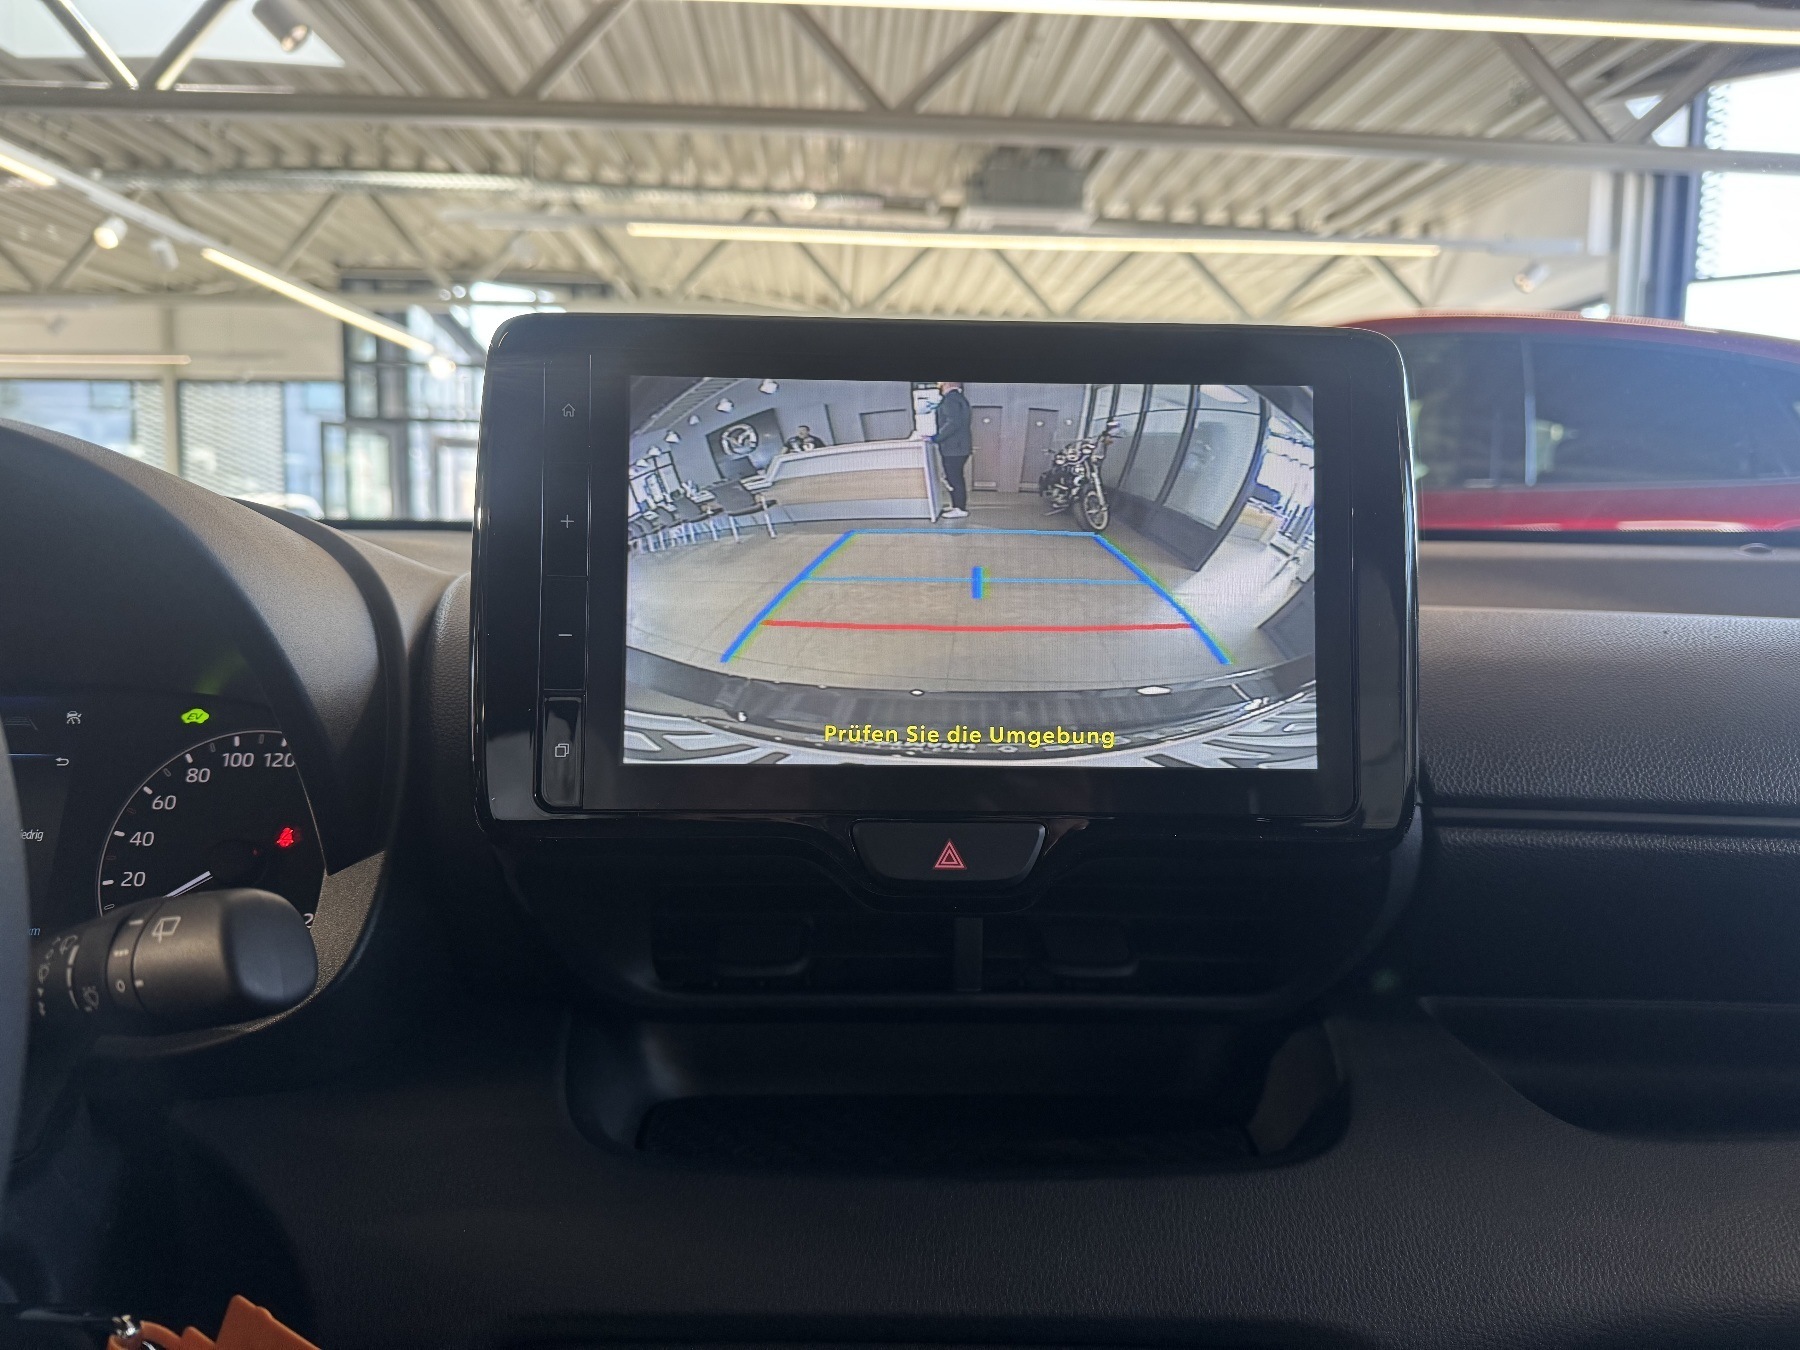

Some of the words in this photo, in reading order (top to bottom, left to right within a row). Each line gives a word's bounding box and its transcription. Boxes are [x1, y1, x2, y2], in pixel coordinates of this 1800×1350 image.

[187, 712, 204, 720] EV
[823, 724, 899, 743] Prüfen
[906, 725, 940, 743] Sie
[946, 725, 982, 744] die
[989, 726, 1116, 748] Umgebung
[222, 752, 255, 767] 100
[263, 752, 295, 767] 120
[185, 767, 211, 783] 80
[152, 795, 177, 810] 60
[129, 831, 155, 847] 40
[120, 871, 146, 887] 20
